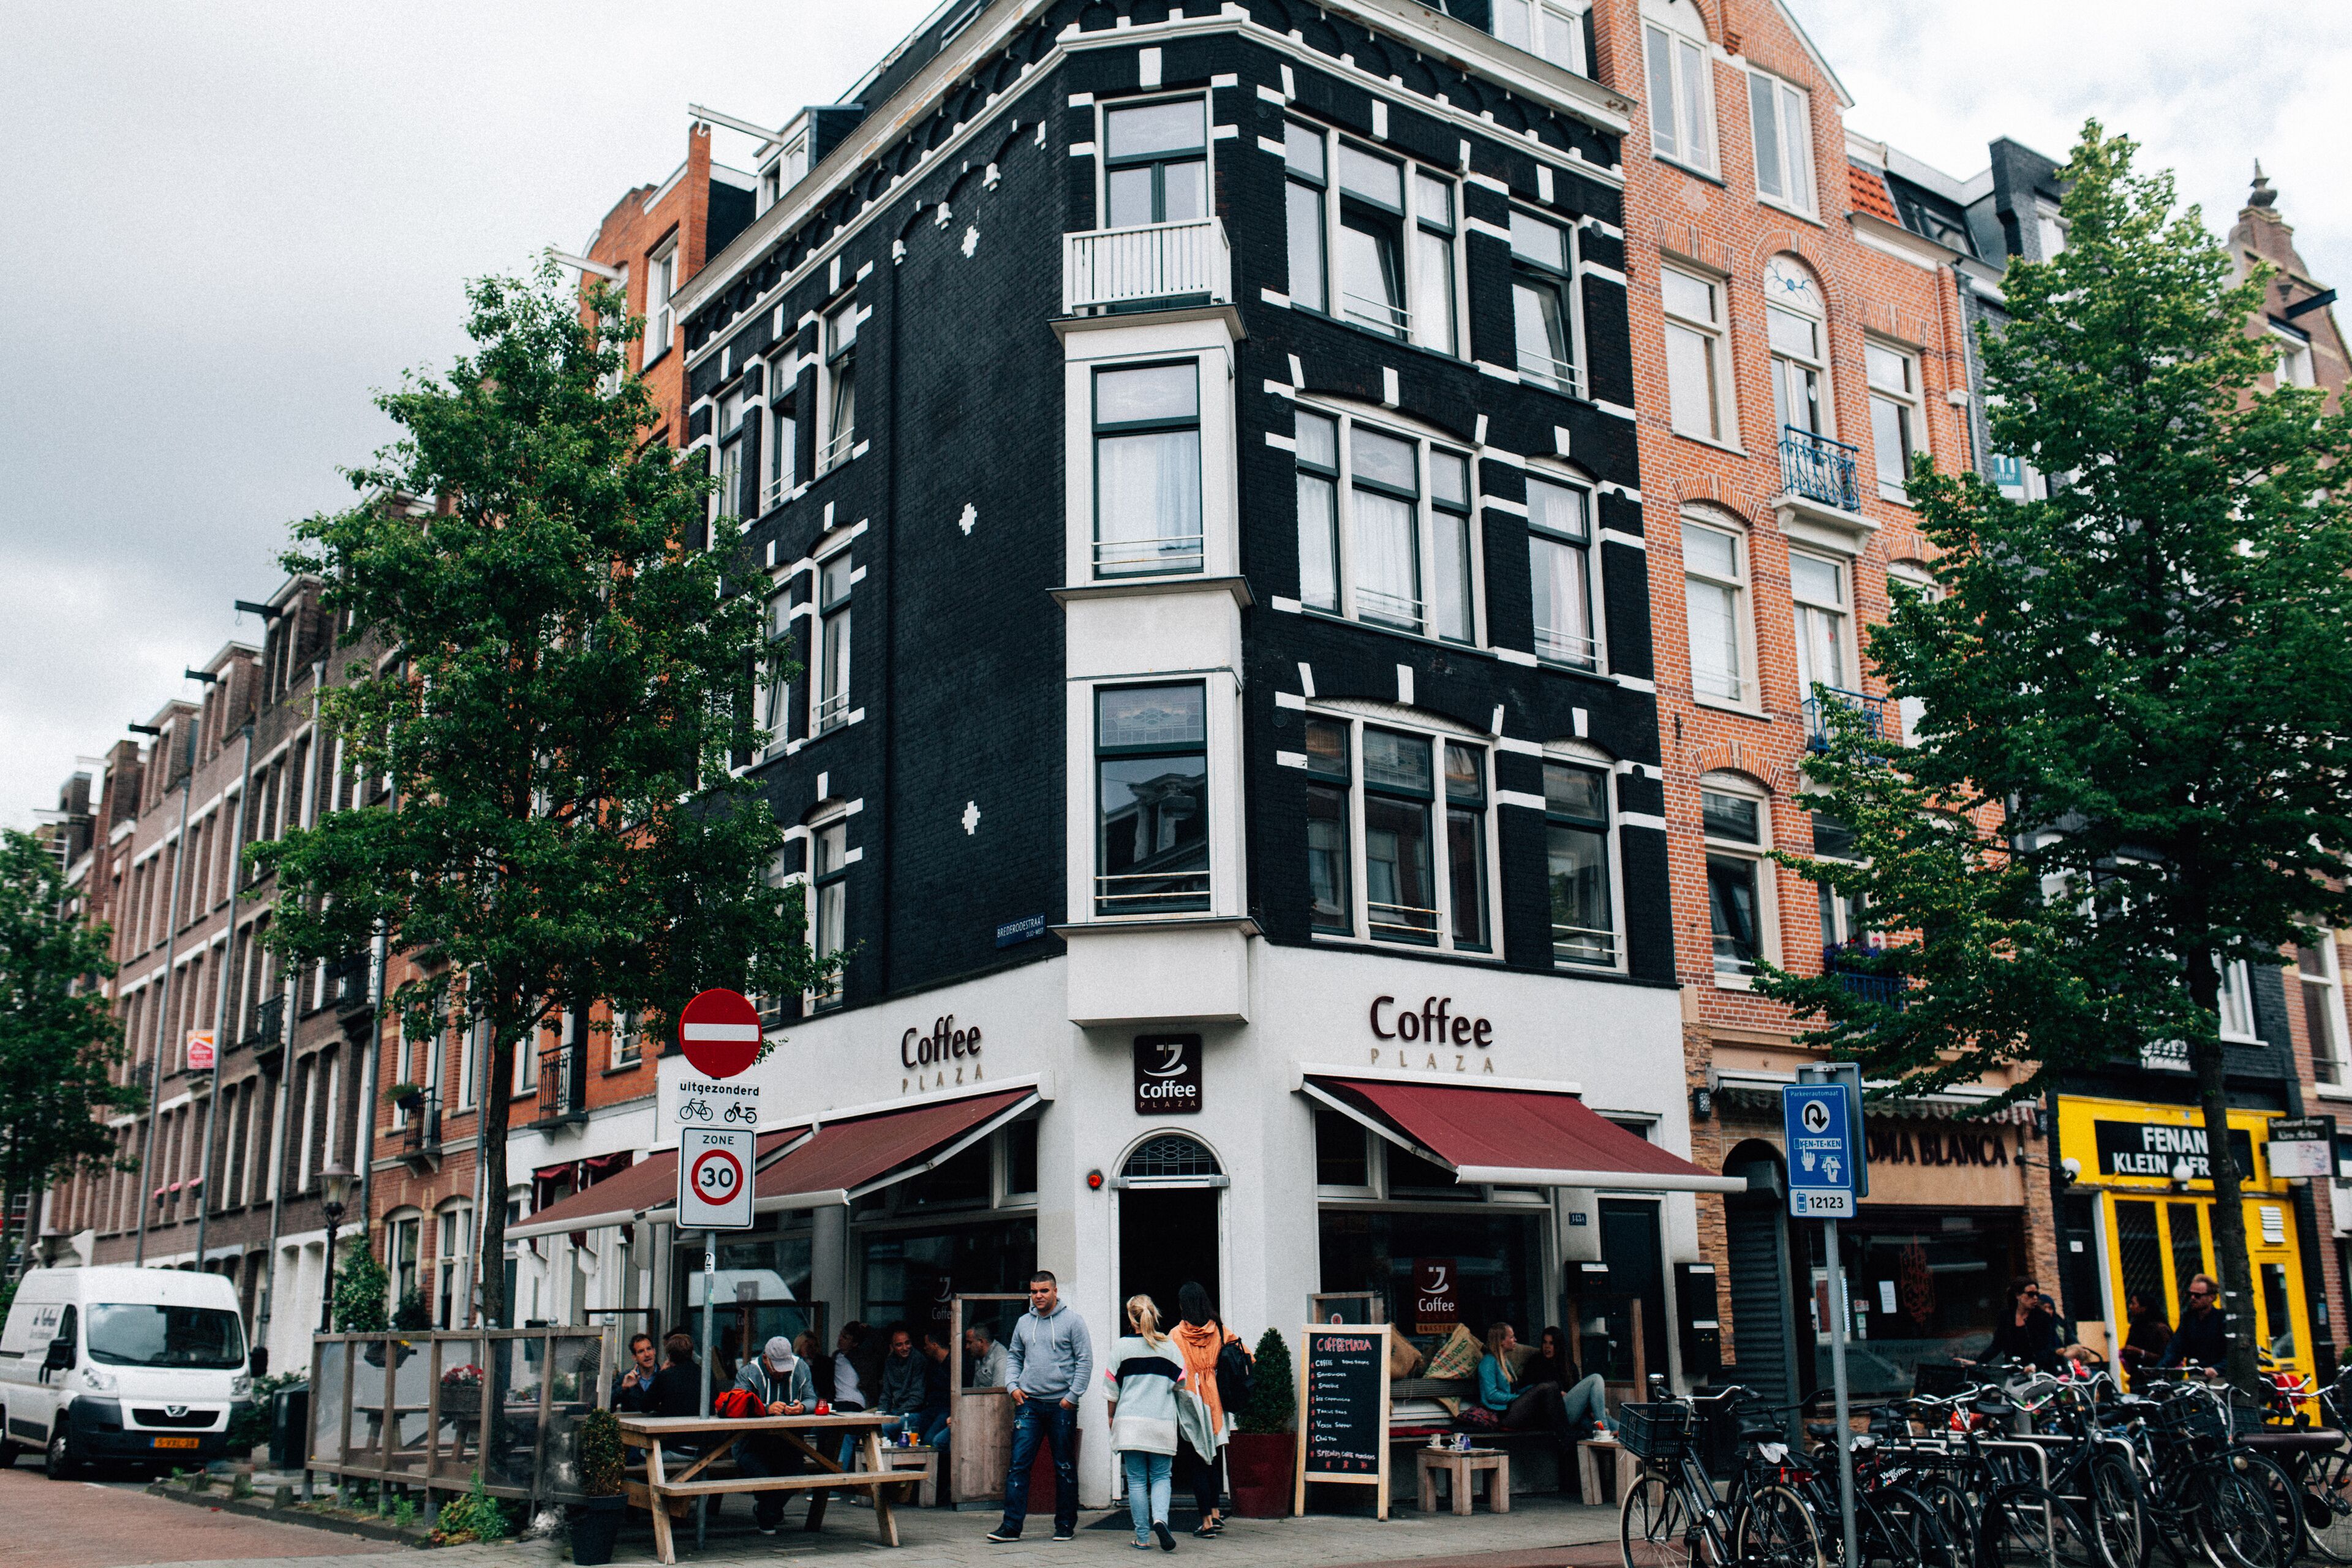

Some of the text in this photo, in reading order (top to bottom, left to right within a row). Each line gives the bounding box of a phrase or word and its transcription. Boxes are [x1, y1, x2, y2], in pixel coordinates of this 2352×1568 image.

[997, 916, 1044, 938] BREDERODESTRAAT
[1025, 927, 1044, 938] OUD-WEST
[1370, 995, 1493, 1046] Coffee
[901, 1014, 981, 1068] Coffee
[1371, 1048, 1494, 1073] PLAZA
[902, 1063, 983, 1093] PLAZA
[680, 1082, 760, 1096] uitgezonderd
[1140, 1080, 1196, 1098] Coffee
[703, 1135, 734, 1145] ZONE
[2142, 1126, 2209, 1154] FENAN
[2113, 1152, 2168, 1174] KLEIN
[701, 1167, 734, 1188] 30
[1809, 1197, 1844, 1210] 12123
[932, 1305, 952, 1319] Coffe
[1418, 1297, 1455, 1312] Coffee
